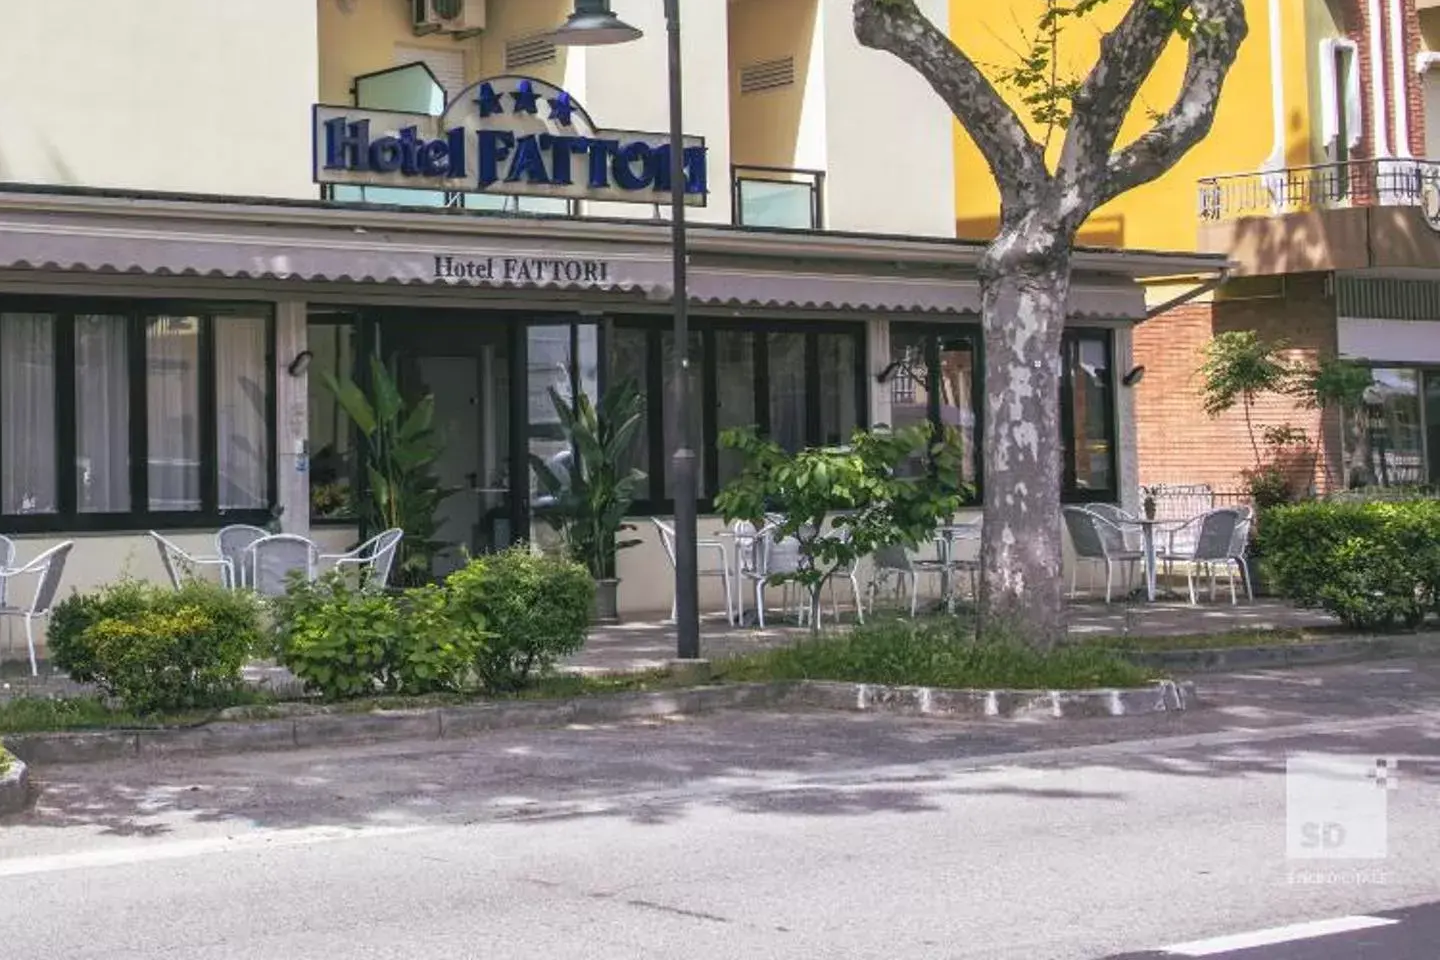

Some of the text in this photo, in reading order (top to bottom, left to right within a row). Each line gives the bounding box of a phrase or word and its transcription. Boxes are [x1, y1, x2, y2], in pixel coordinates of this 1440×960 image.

[324, 117, 467, 178] Hotel
[433, 257, 608, 281] Hotel FATTORI
